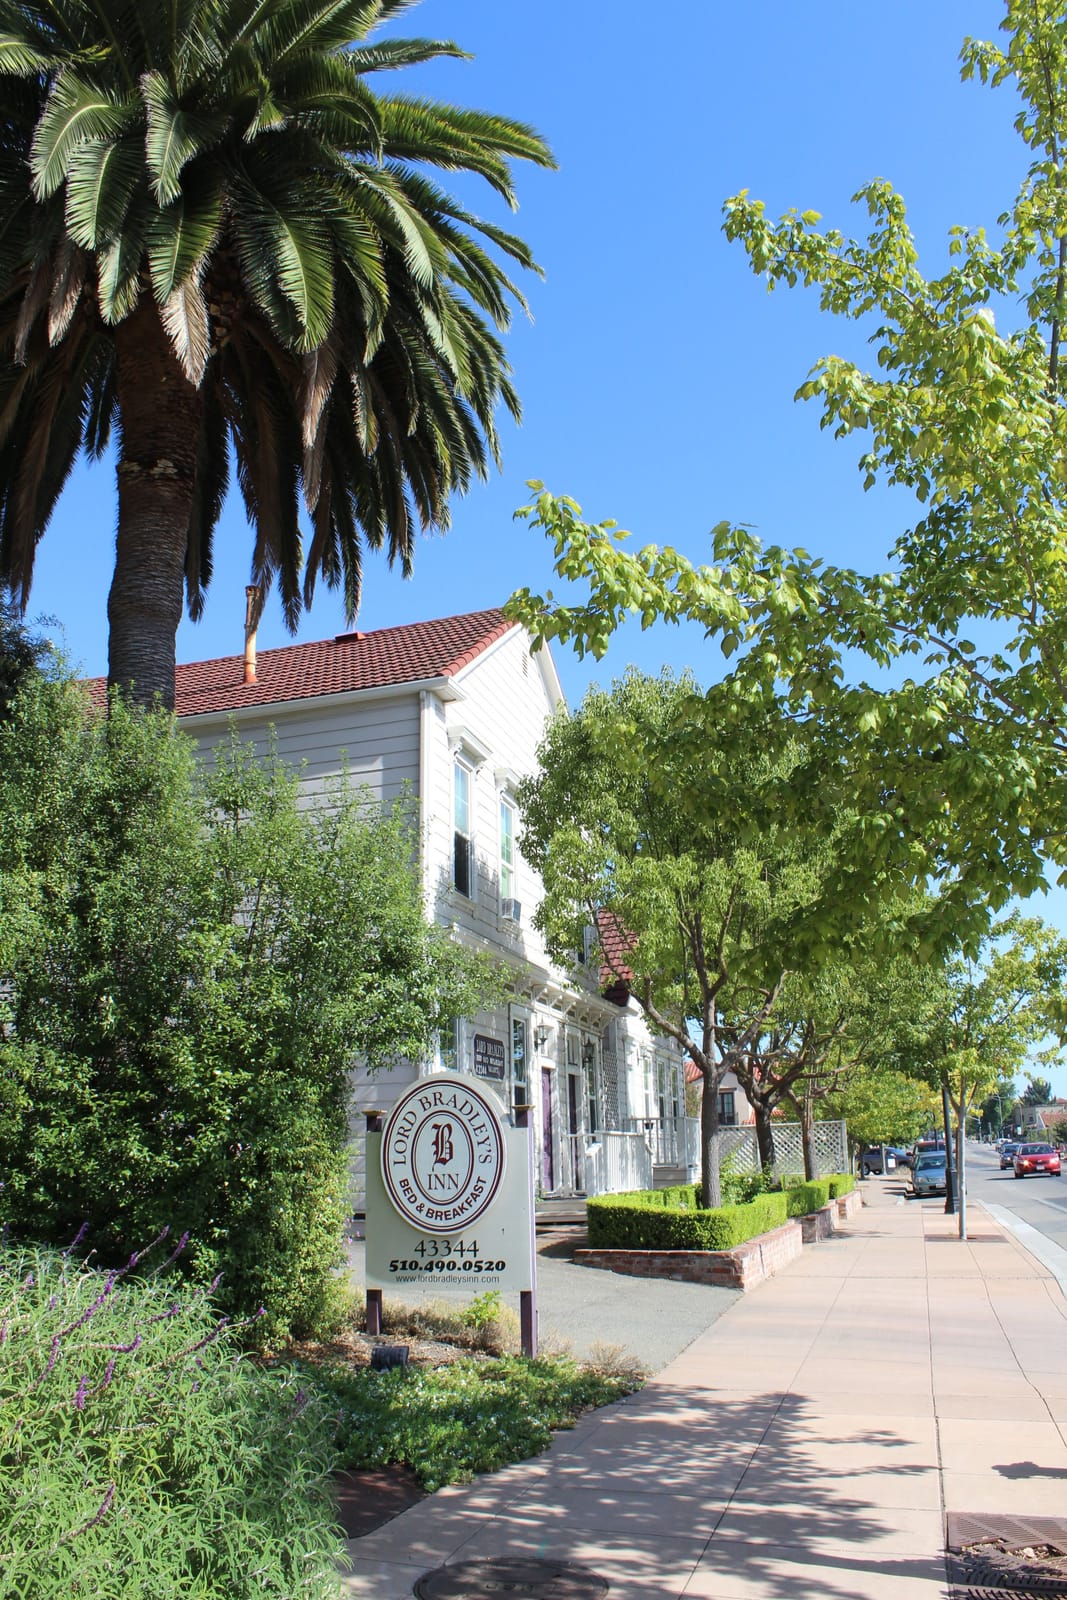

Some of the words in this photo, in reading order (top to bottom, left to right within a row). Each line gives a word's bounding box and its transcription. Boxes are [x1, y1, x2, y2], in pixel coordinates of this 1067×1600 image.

[393, 1110, 417, 1166] LORD
[418, 1091, 492, 1164] BRADLEY'S
[431, 1122, 454, 1172] B
[399, 1178, 418, 1204] BED
[415, 1202, 426, 1214] &
[425, 1175, 487, 1221] BREAKFAST
[427, 1173, 460, 1191] INN
[414, 1239, 480, 1258] 43344
[389, 1259, 506, 1273] 510.490.0520
